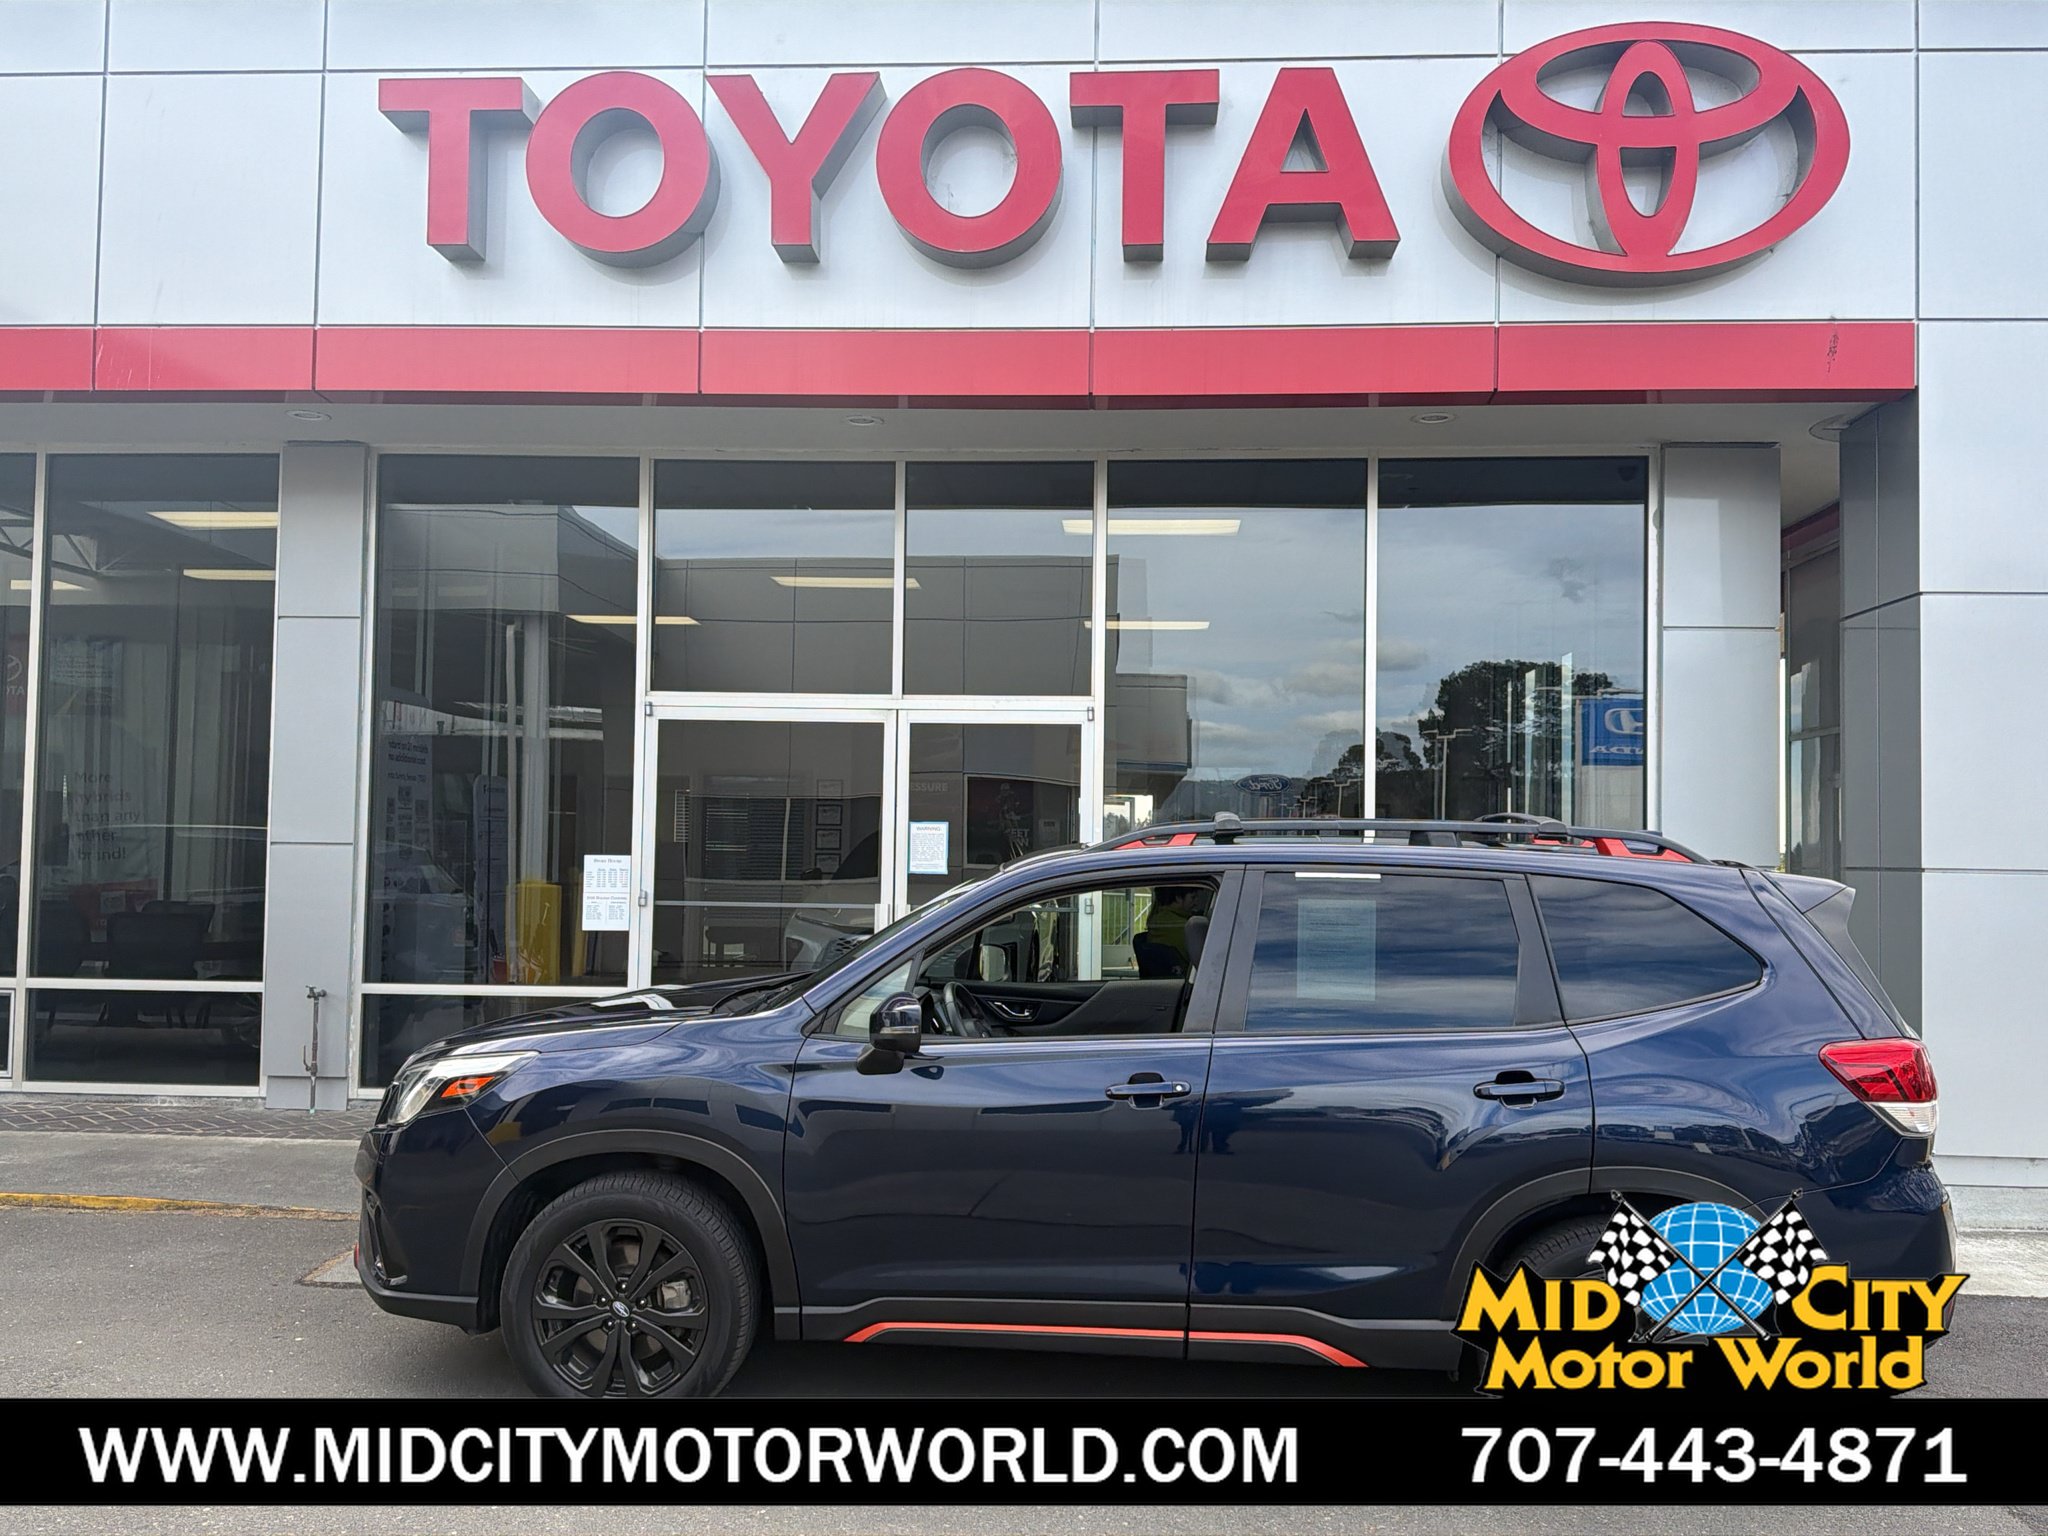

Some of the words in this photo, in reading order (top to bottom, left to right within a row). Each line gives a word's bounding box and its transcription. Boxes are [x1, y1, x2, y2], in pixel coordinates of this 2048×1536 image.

[378, 67, 1400, 262] TOYOTA
[74, 772, 113, 783] More
[114, 811, 141, 823] any
